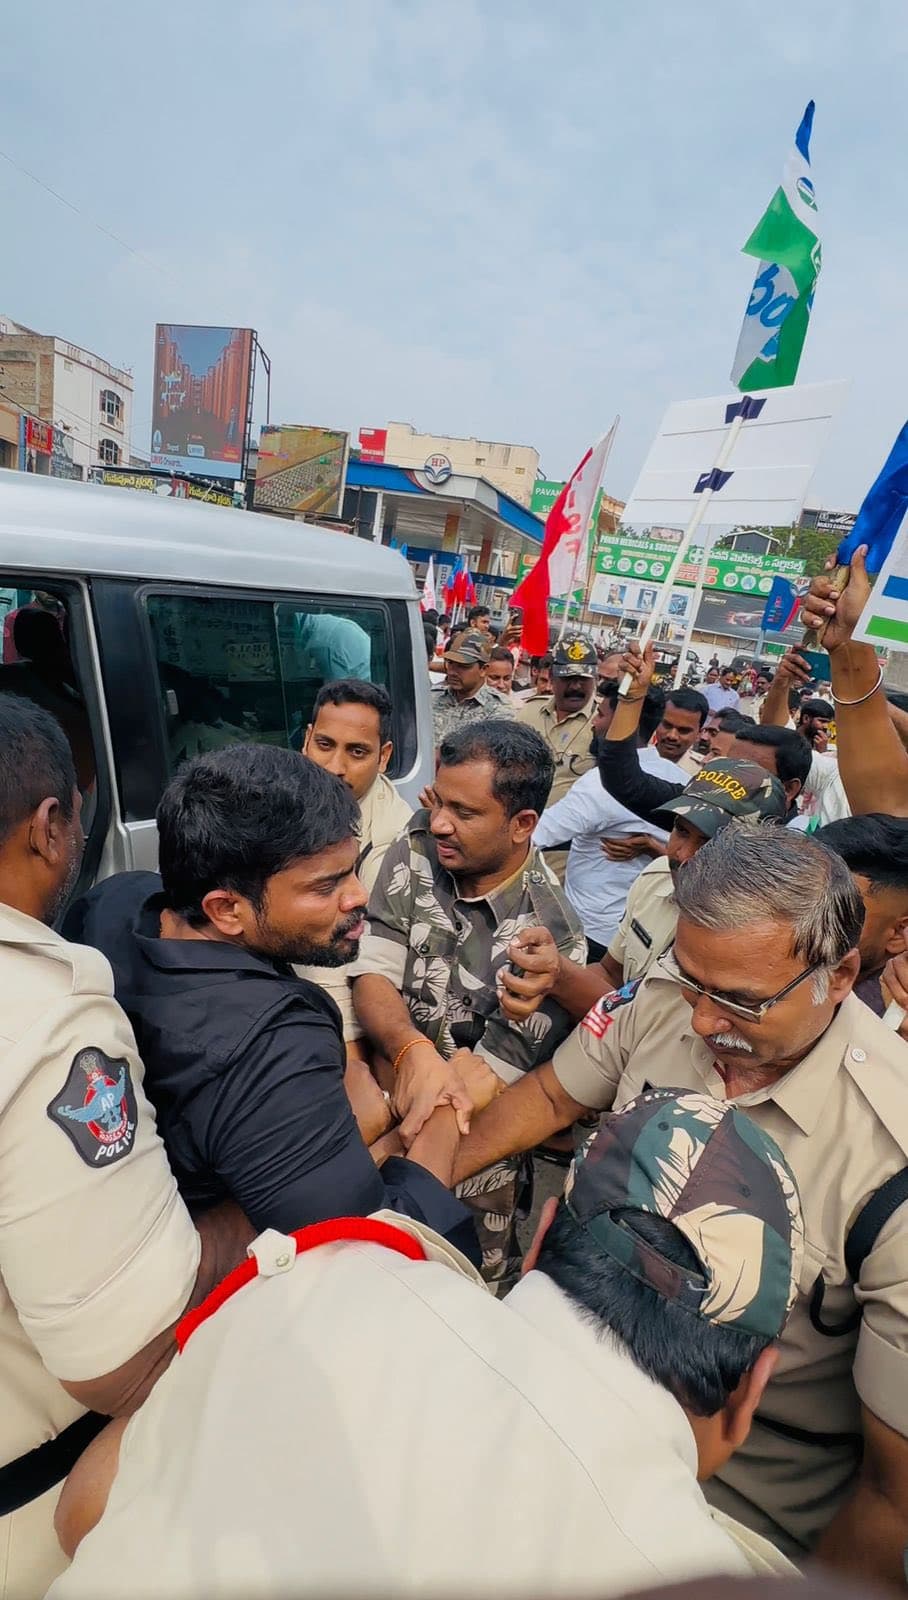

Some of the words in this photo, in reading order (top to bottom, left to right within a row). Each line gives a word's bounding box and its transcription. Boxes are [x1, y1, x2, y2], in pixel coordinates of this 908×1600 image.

[431, 457, 446, 467] HP
[695, 770, 747, 800] POLICE
[100, 1092, 116, 1112] AP
[94, 1121, 135, 1161] POLICE
